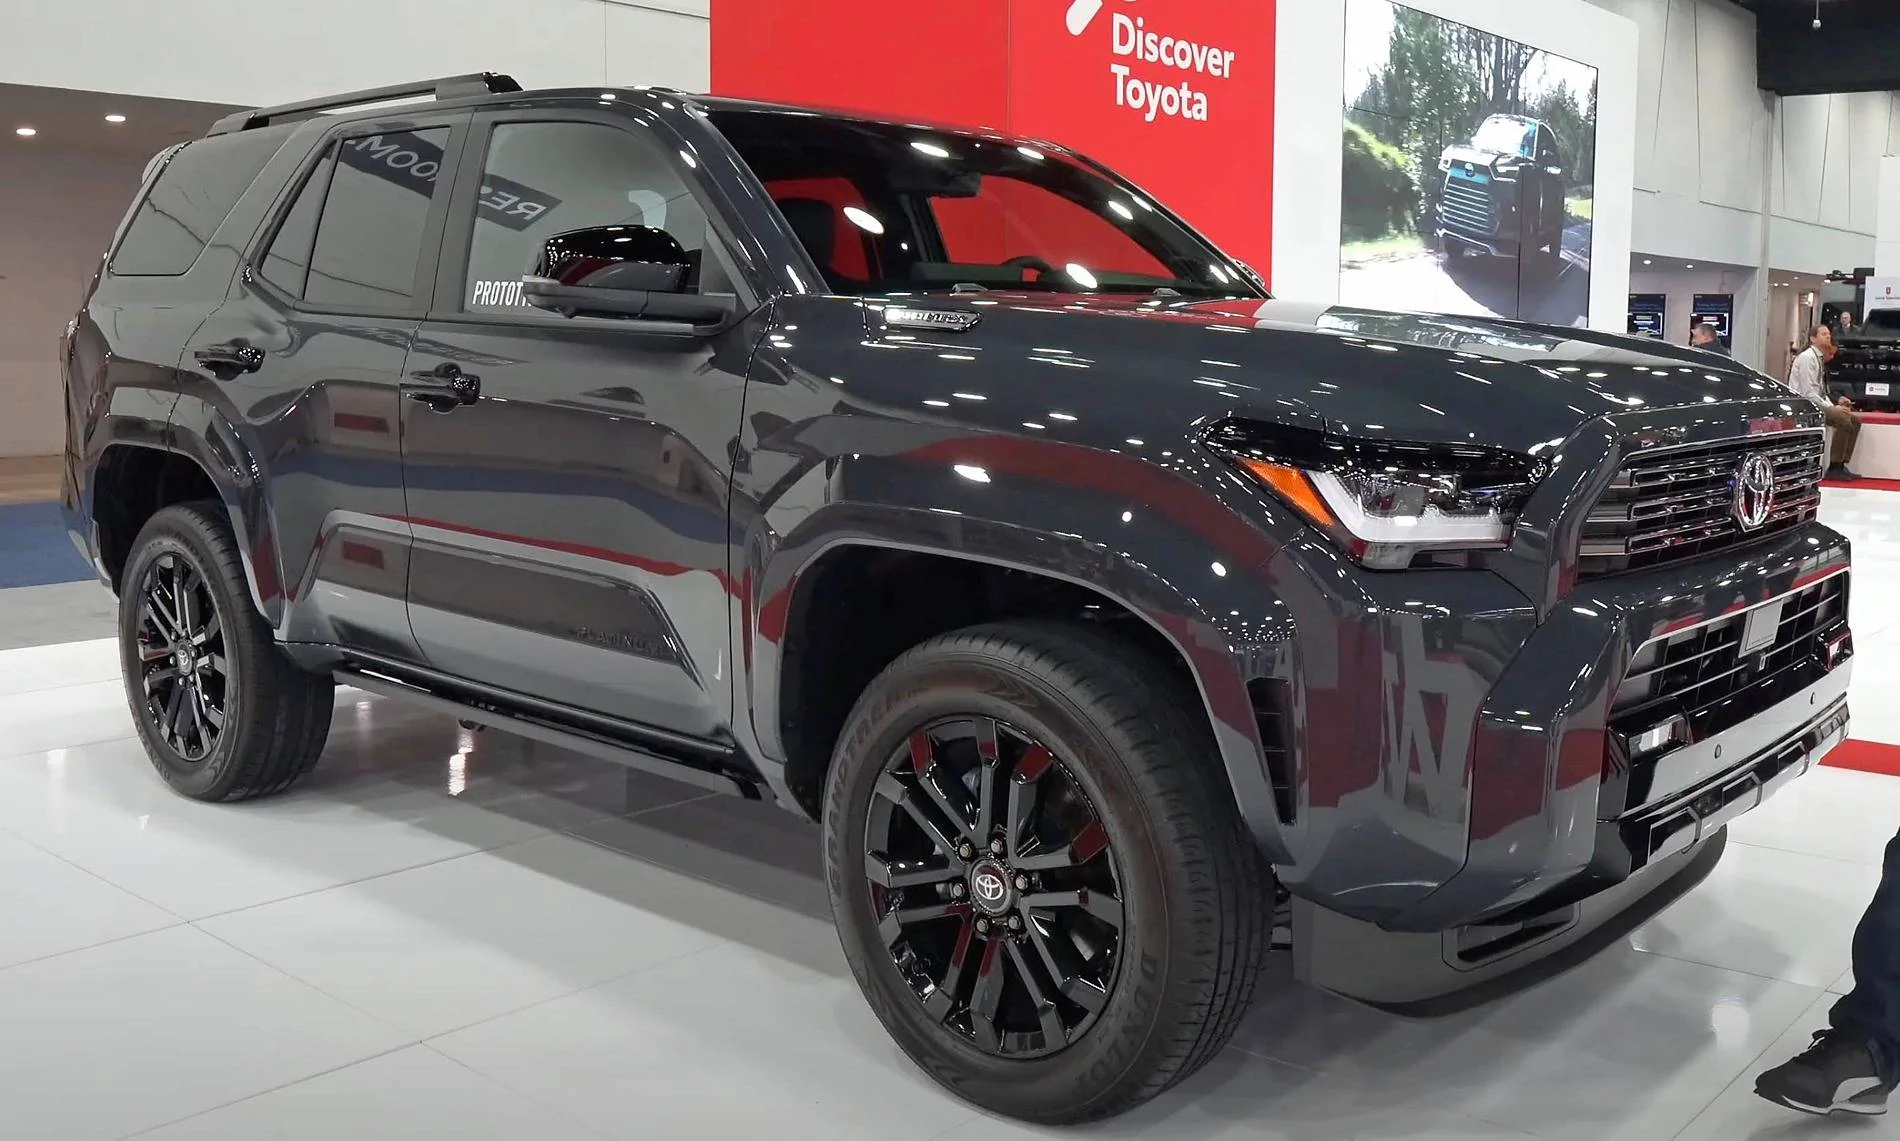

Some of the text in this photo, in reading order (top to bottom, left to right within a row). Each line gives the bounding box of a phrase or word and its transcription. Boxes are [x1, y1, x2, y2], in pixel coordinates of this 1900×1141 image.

[1112, 12, 1235, 78] Discover
[1110, 64, 1208, 122] Toyota
[472, 280, 532, 307] PROTOT
[1072, 948, 1158, 1098] DUNLOP
